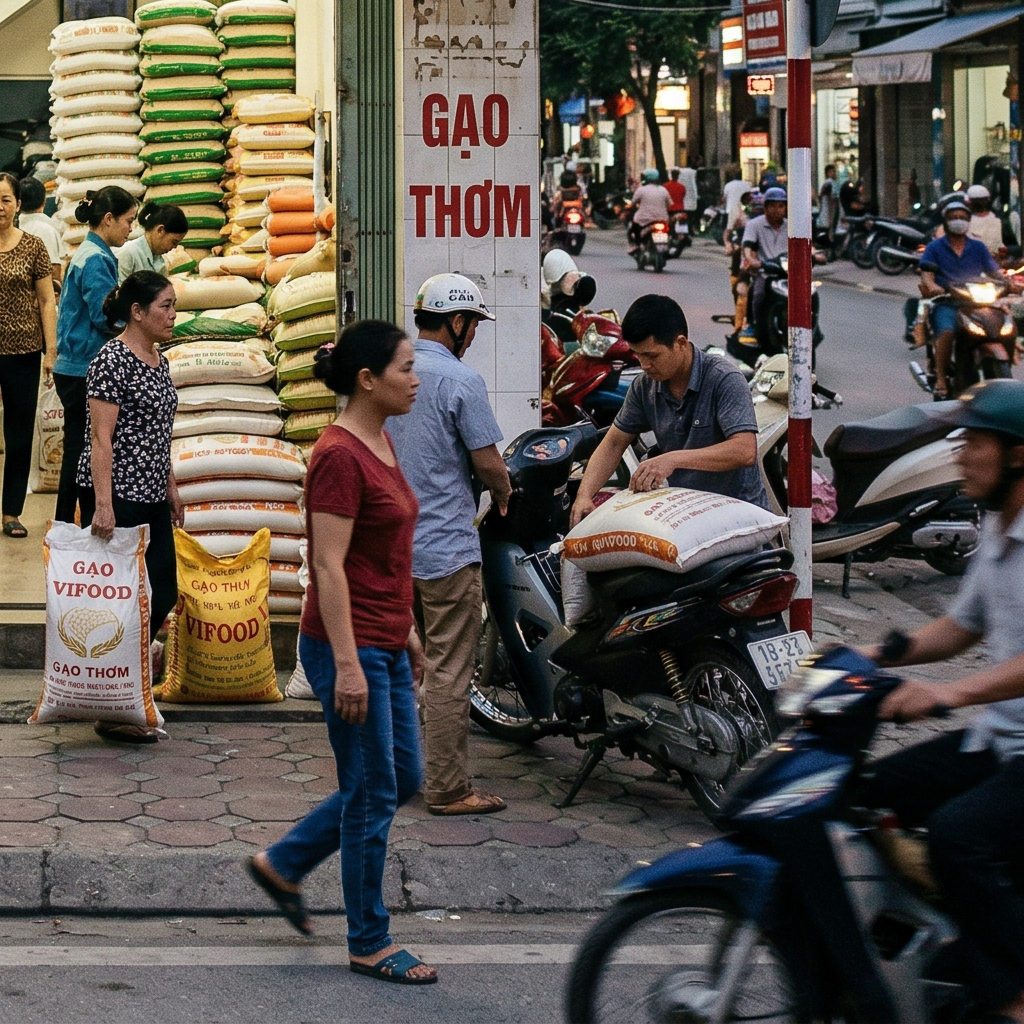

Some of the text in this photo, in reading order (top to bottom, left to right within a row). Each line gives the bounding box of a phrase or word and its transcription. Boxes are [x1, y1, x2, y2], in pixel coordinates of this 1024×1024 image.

[422, 93, 509, 159] GẠO
[409, 179, 531, 238] THƠM
[72, 561, 114, 578] GẠO
[53, 581, 132, 600] VIFOOD
[192, 580, 217, 595] GẠO
[186, 613, 259, 643] VIFOOD
[53, 662, 130, 679] GẠO THƠM
